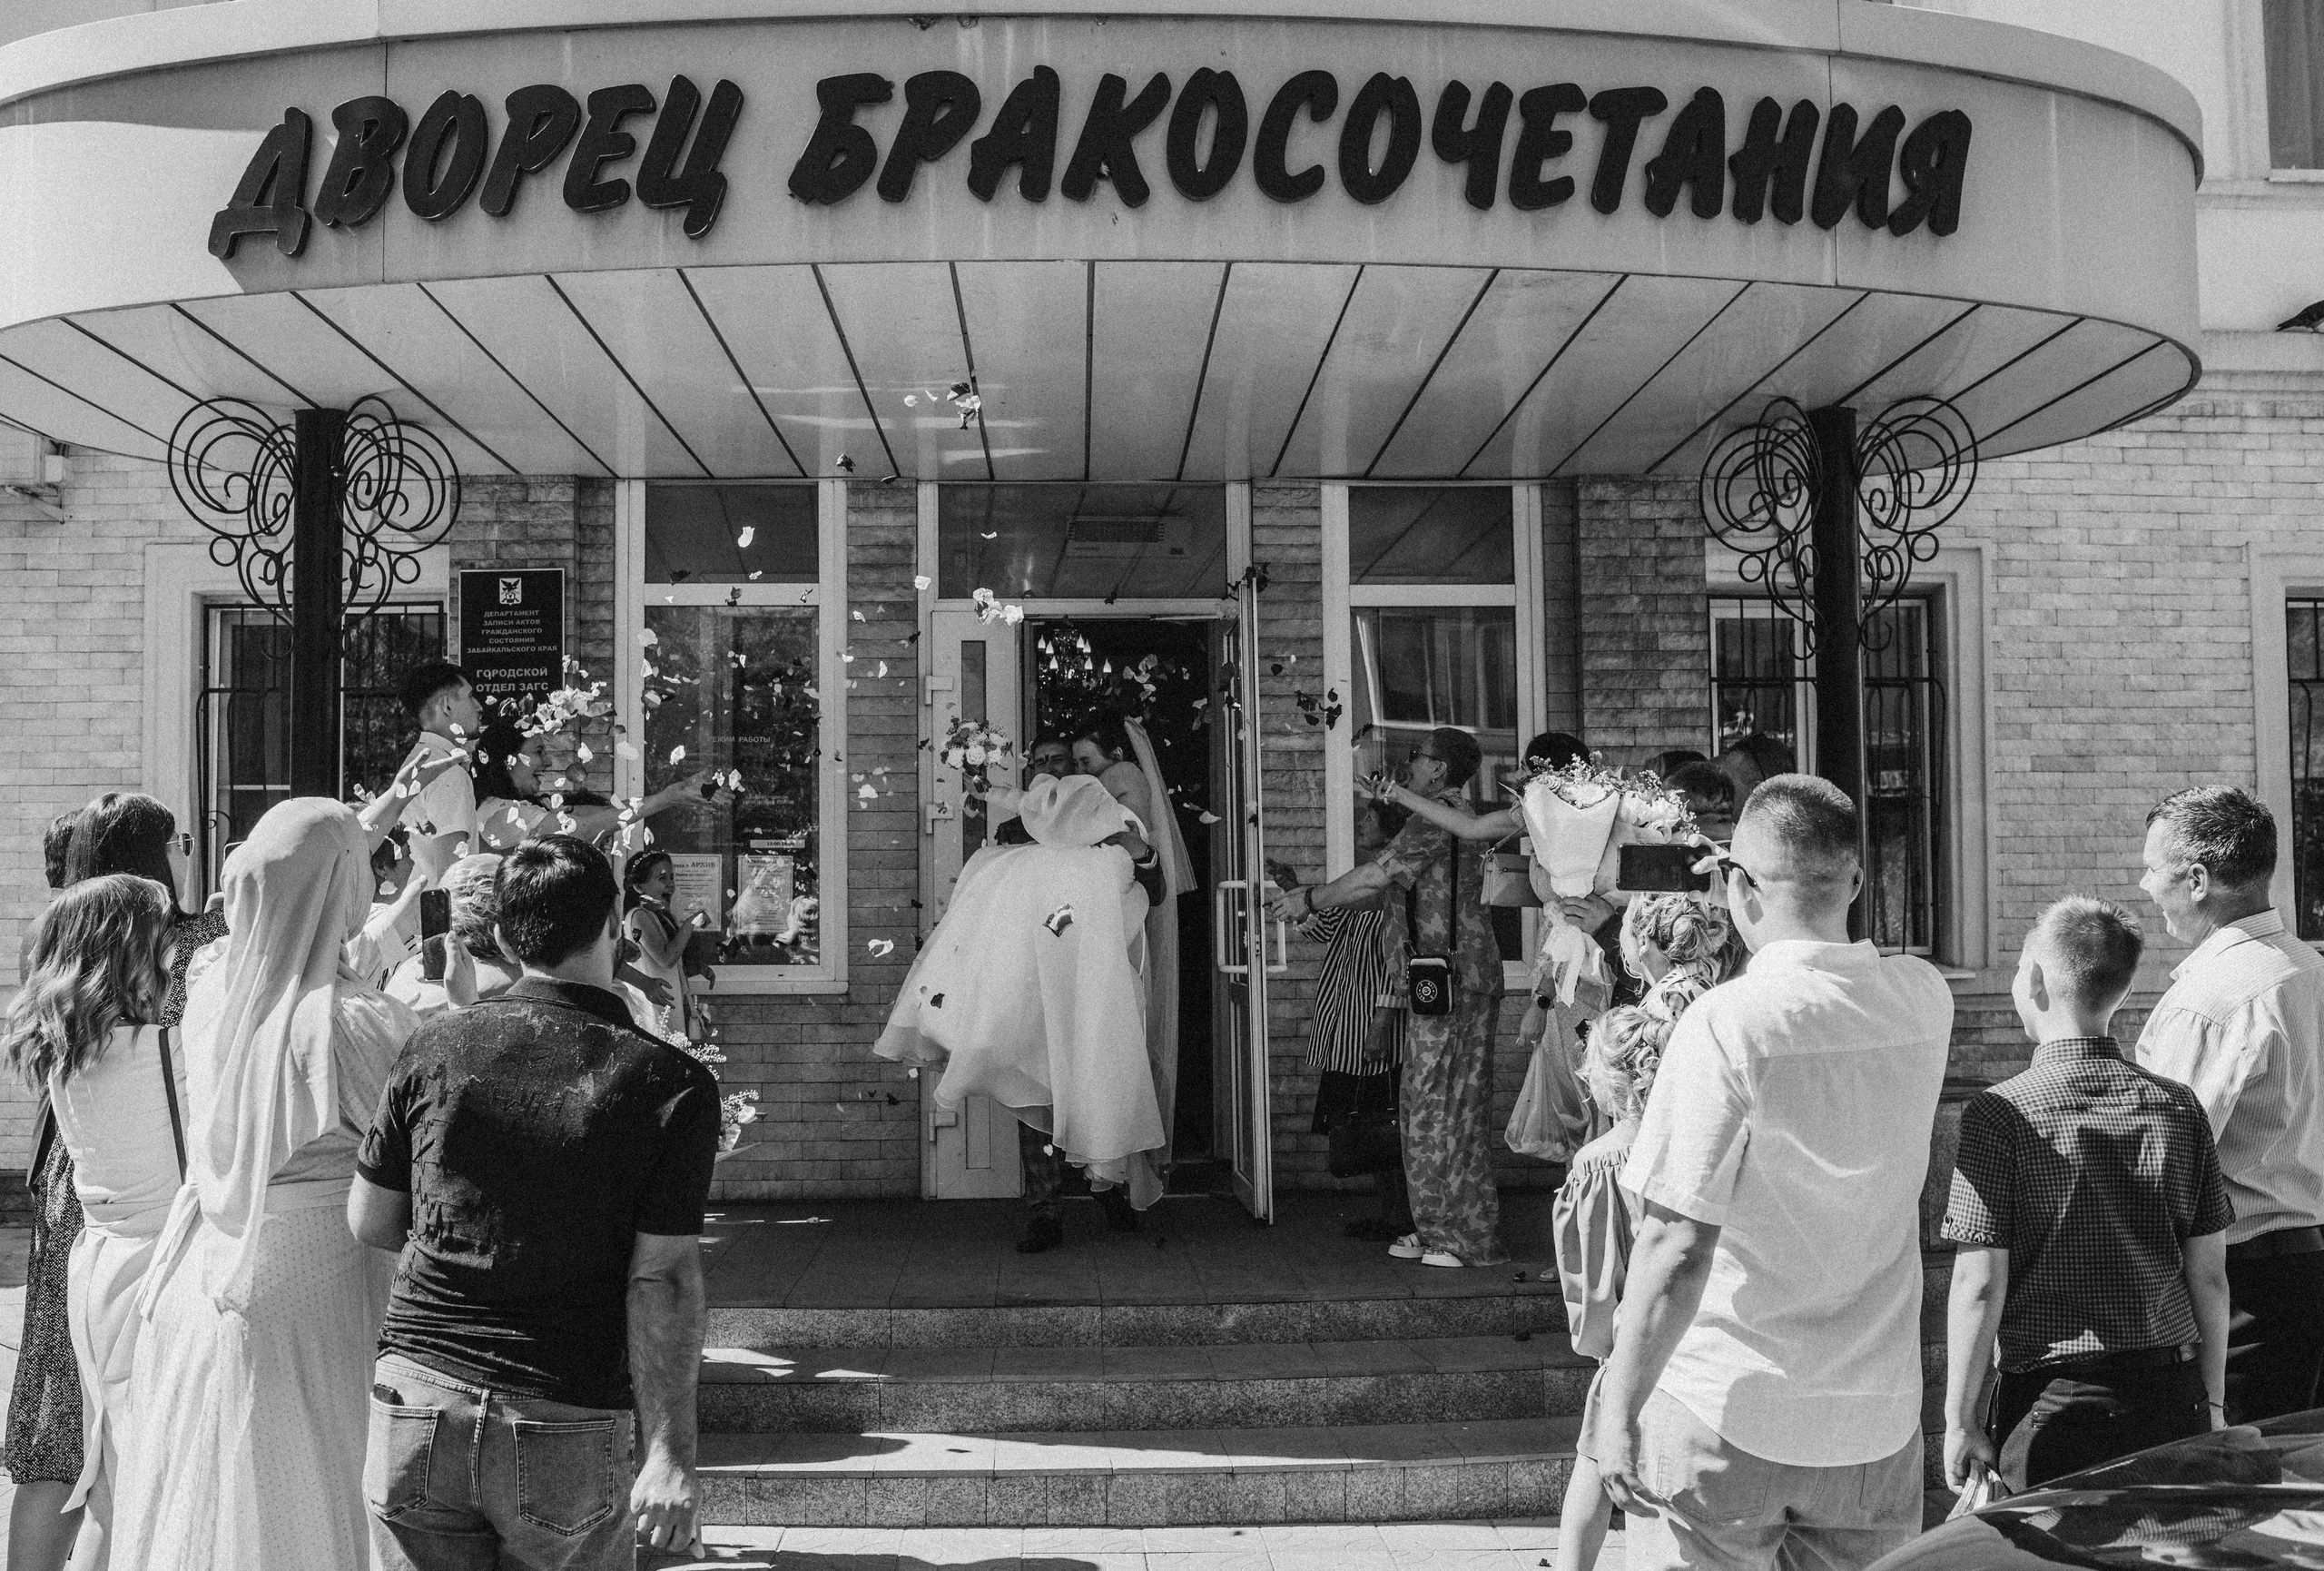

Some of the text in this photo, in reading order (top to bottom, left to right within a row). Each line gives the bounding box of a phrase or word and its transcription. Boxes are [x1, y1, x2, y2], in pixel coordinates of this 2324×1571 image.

[208, 64, 1974, 260] ДВОРЕЦ БРАКОСОЧЕТАНИЯ
[467, 646, 536, 654] ЗАБАЙКАЛЬСКОГО
[477, 667, 548, 679] ГОРОДСКОЙ
[477, 682, 548, 693] ОТДЕЛ ЗАГС
